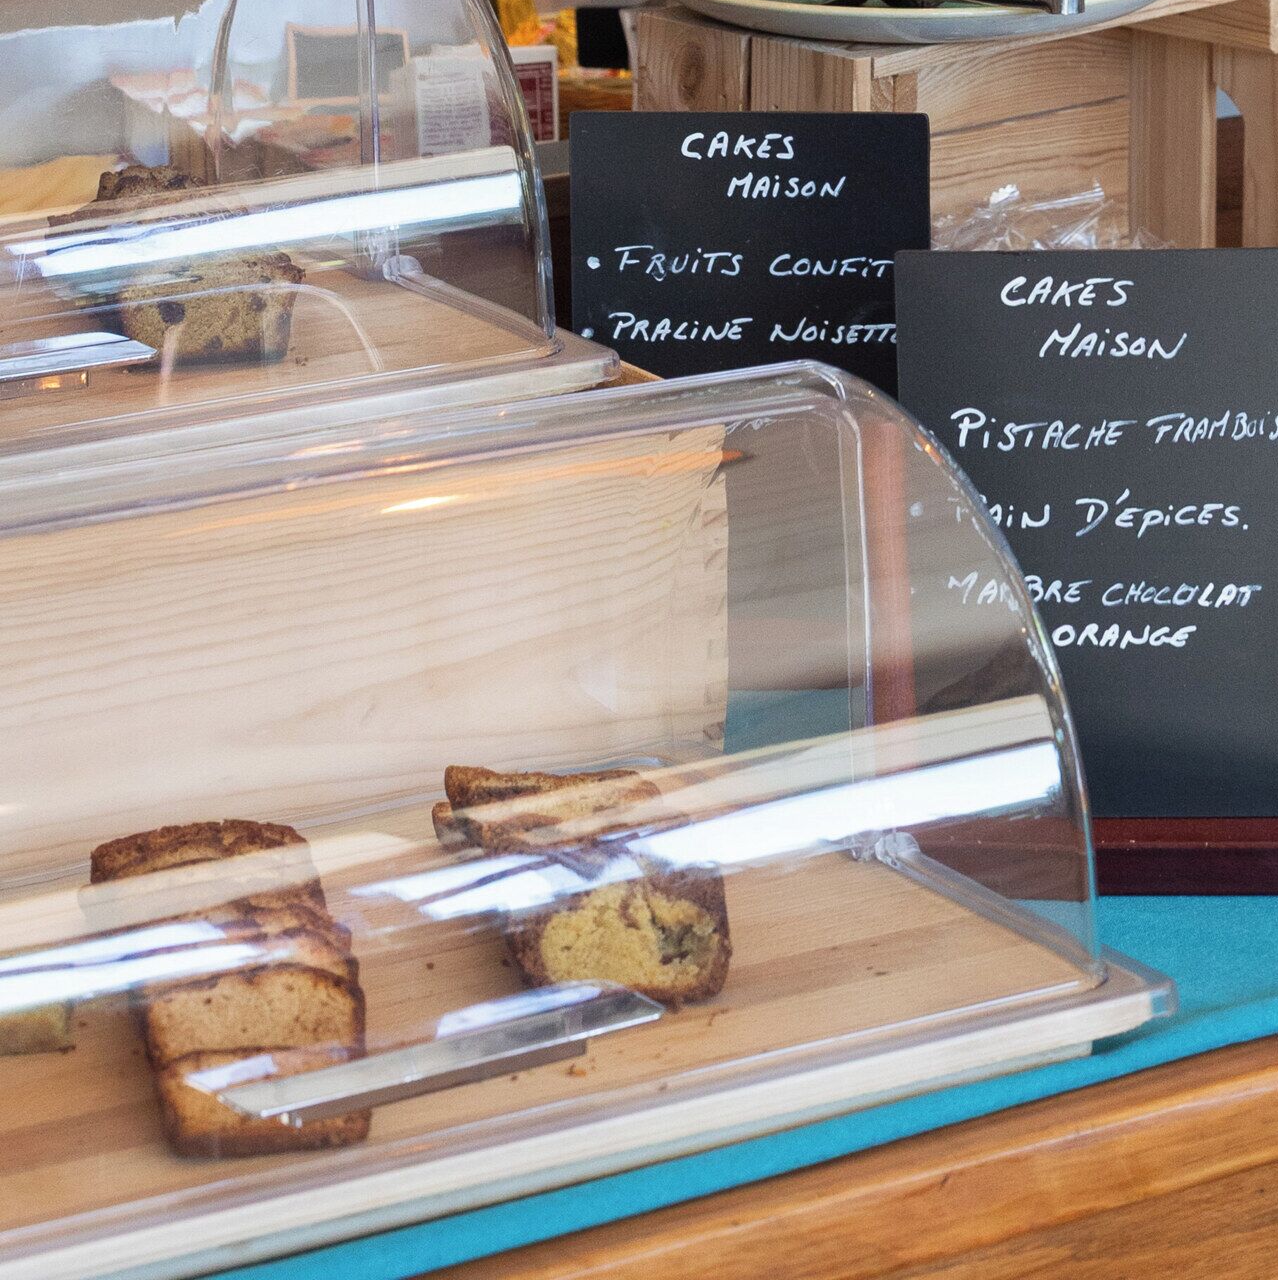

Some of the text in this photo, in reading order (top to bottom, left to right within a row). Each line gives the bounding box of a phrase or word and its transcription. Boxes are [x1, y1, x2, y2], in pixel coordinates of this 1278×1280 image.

[681, 131, 795, 160] CAKES
[1000, 275, 1135, 307] CAKES
[1101, 581, 1263, 608] CHOCOLAT
[1052, 623, 1198, 650] ORANGE
